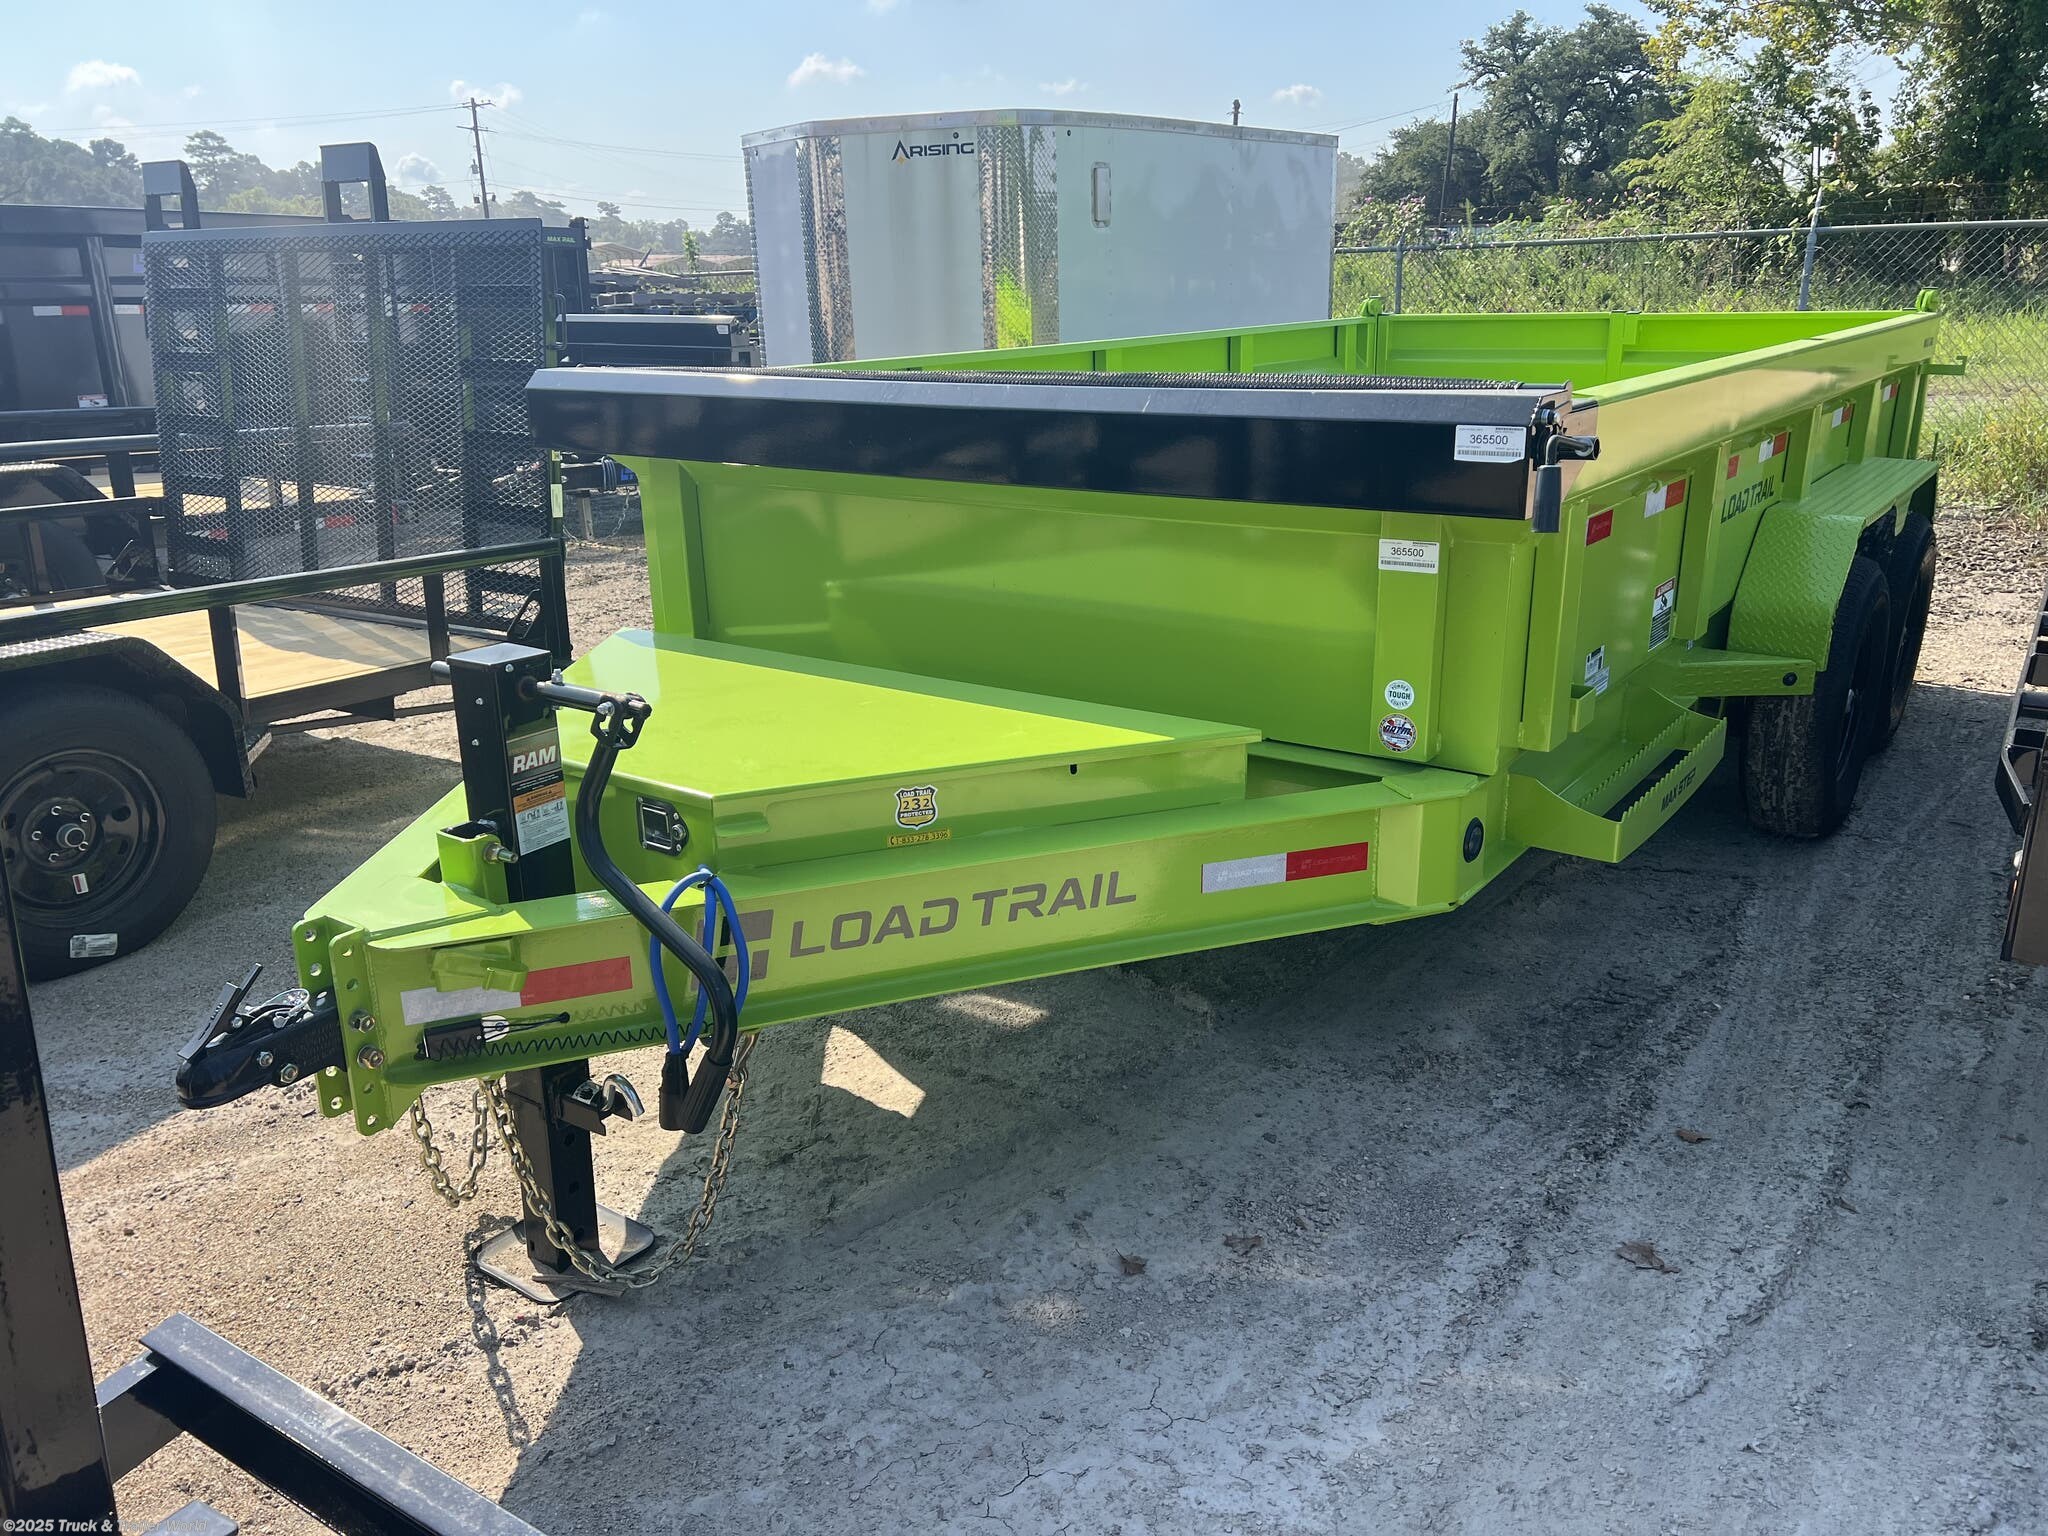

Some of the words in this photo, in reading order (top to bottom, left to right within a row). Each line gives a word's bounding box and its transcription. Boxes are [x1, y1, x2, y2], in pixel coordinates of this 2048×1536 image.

[1470, 434, 1509, 445] 365500
[1720, 487, 1750, 524] LOAD
[1751, 474, 1775, 508] TRAIL
[1391, 547, 1424, 558] 365500
[1389, 690, 1411, 700] TOUGH
[512, 745, 557, 775] RAM
[1660, 787, 1677, 812] MAX
[1676, 766, 1696, 796] STEP
[900, 810, 933, 818] PROTECTED
[789, 897, 959, 958] LOAD
[972, 871, 1137, 926] TRAIL
